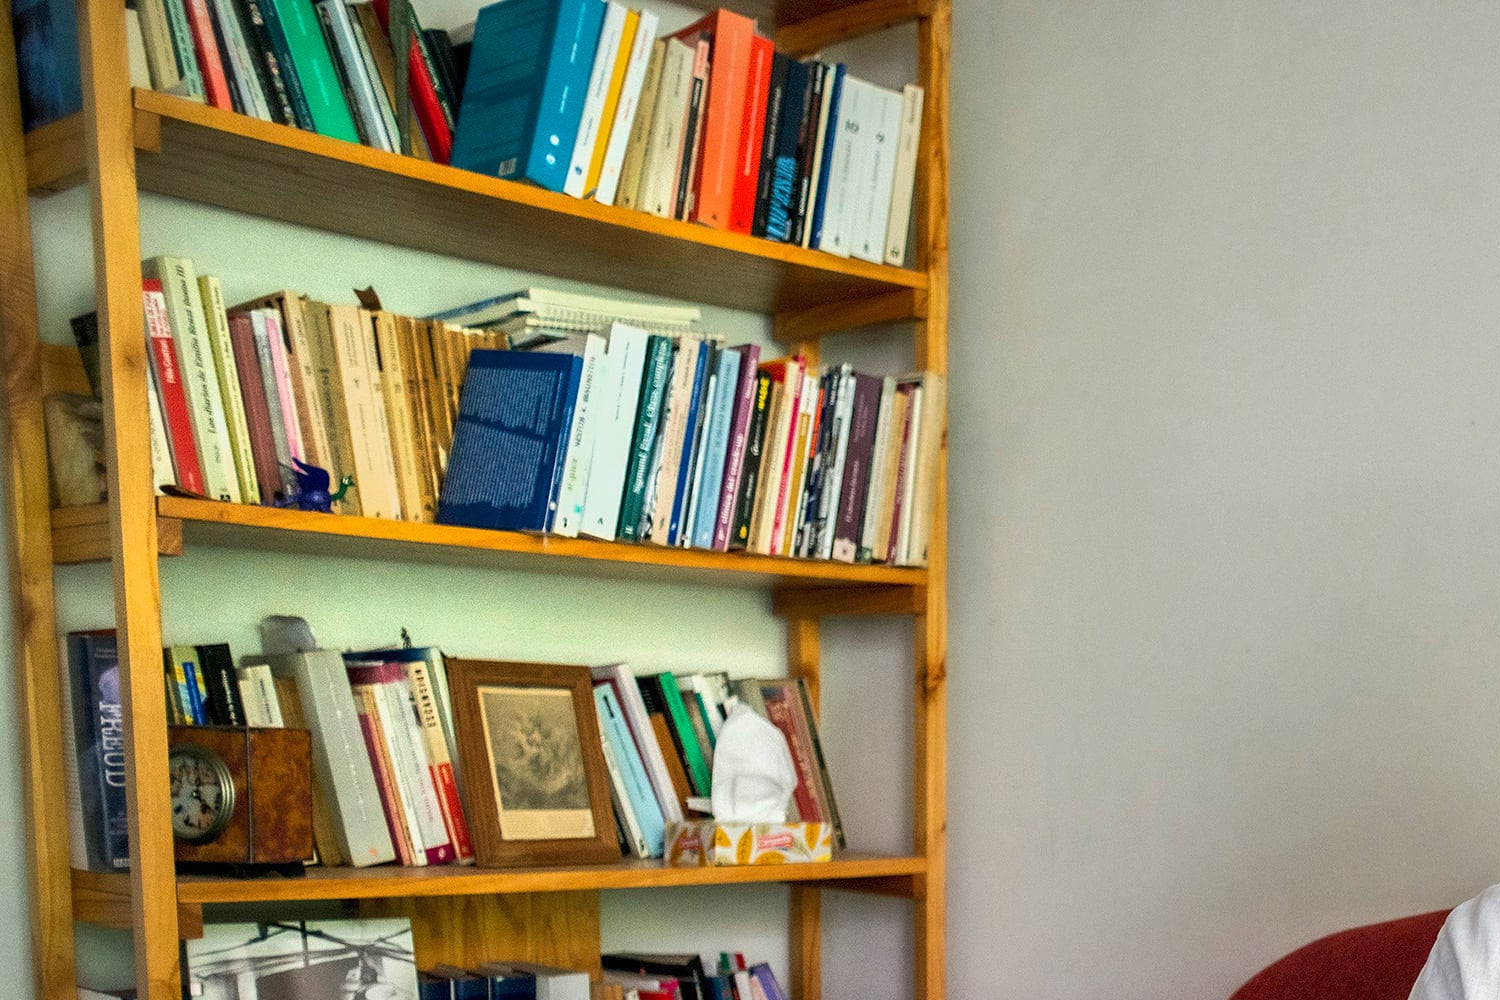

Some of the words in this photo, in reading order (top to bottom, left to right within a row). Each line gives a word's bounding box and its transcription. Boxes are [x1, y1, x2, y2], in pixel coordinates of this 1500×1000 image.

[633, 452, 647, 494] Sigmund
[640, 424, 652, 452] Freud
[730, 434, 743, 476] crack-up
[727, 478, 735, 493] del
[722, 494, 733, 524] clínica
[99, 702, 126, 788] FREUD
